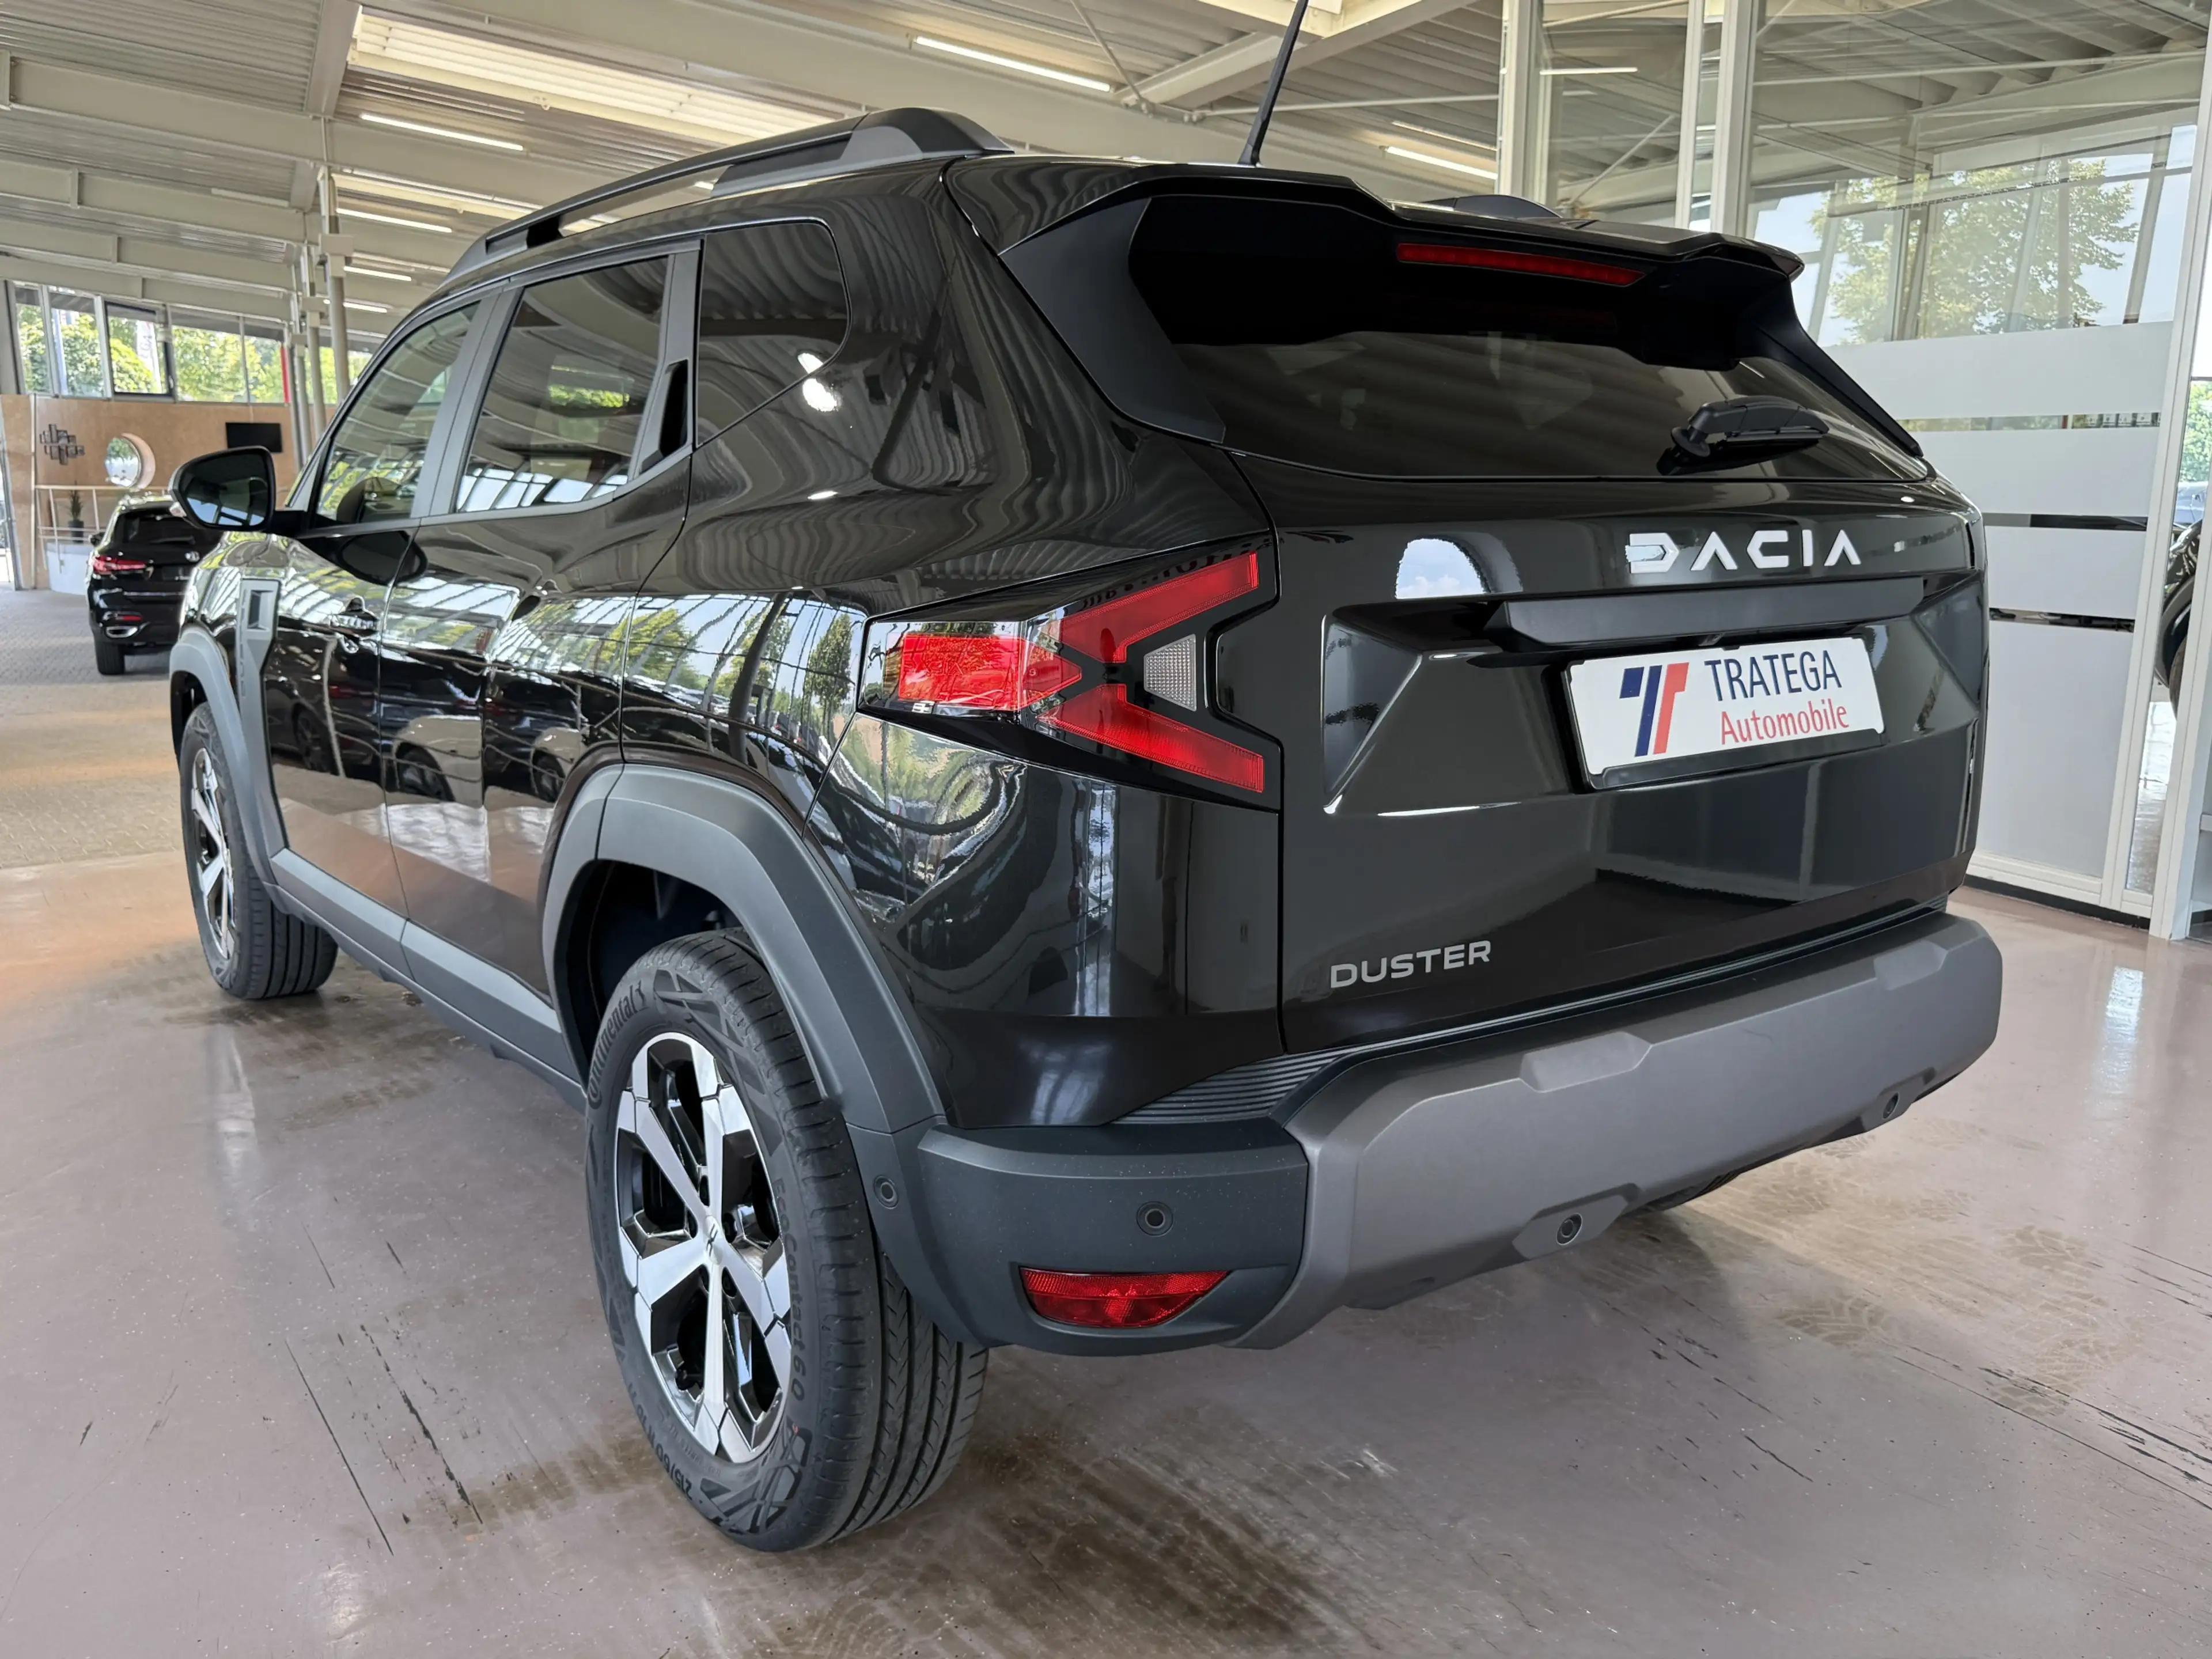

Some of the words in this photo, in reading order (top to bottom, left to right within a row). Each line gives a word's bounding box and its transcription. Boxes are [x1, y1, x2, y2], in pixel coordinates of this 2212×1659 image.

[1628, 528, 1862, 574] DACIA
[1704, 649, 1842, 702] TRATEGA
[1721, 699, 1850, 745] Automobile
[1330, 940, 1492, 989] DUSTER
[772, 1176, 806, 1350] EcoContact
[793, 1354, 807, 1377] 6
